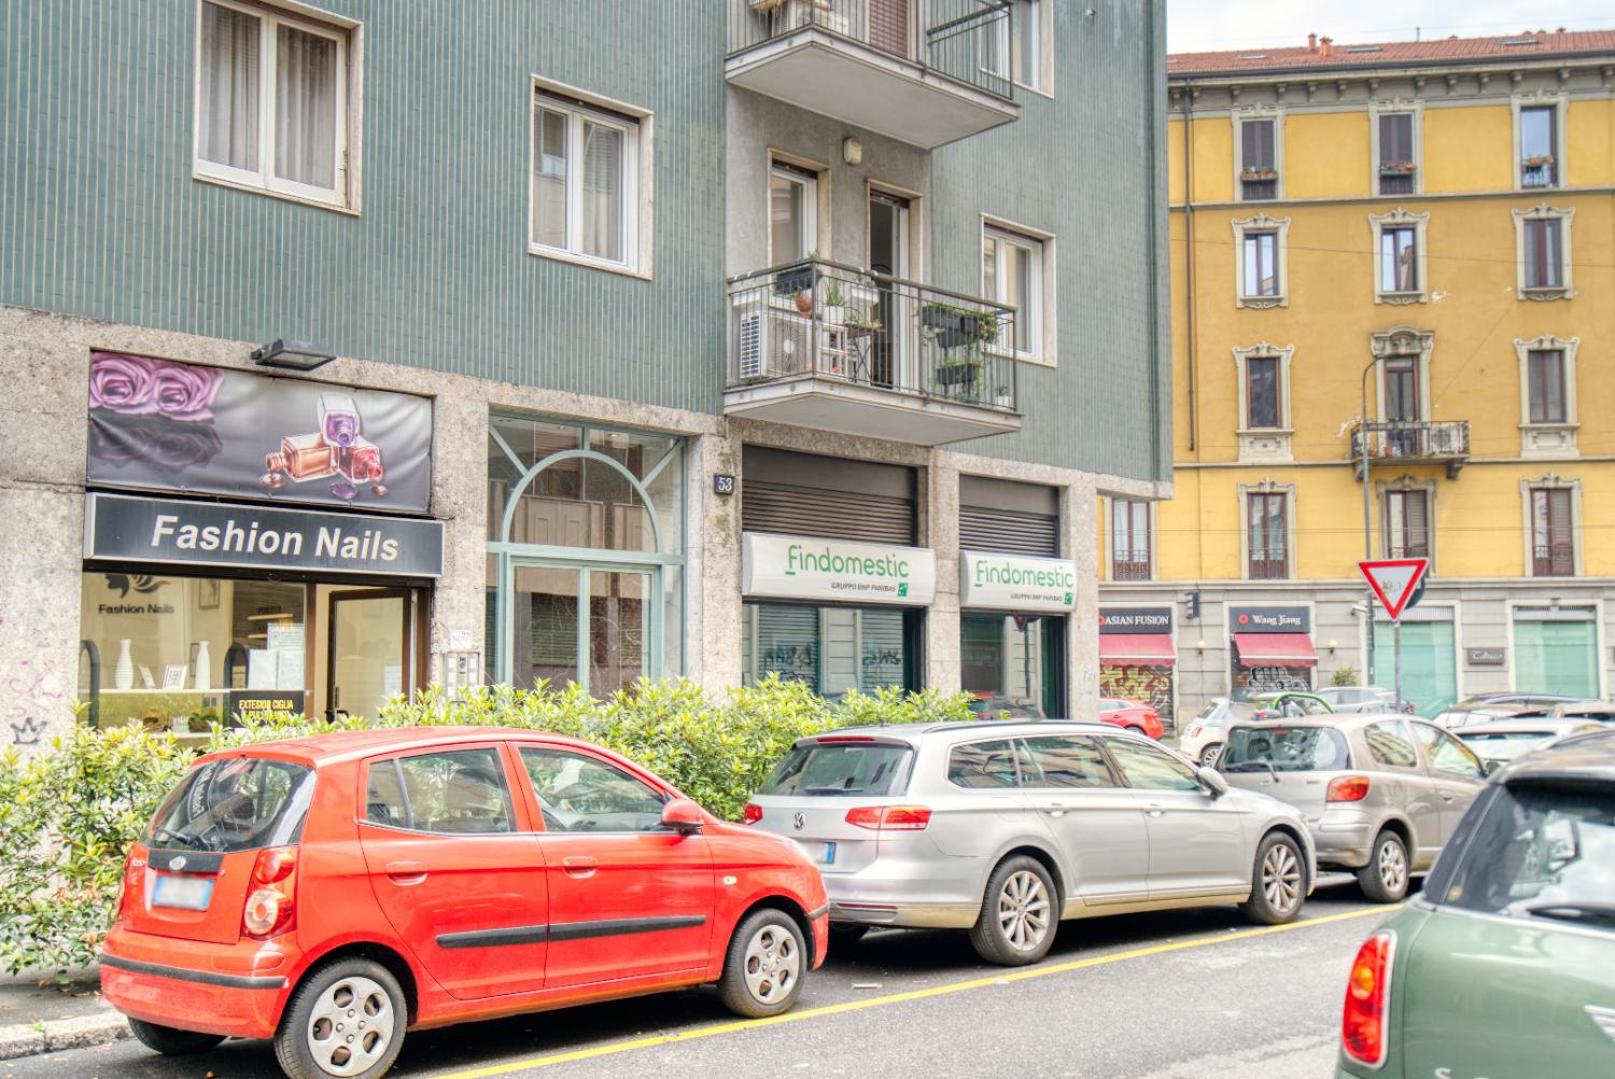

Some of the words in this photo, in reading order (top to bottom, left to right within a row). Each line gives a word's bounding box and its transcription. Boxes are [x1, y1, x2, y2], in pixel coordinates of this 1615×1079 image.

[718, 476, 732, 491] 53
[151, 514, 303, 556] Fashion
[315, 526, 399, 561] Nails
[785, 544, 909, 578] findomestic
[974, 559, 1074, 588] findomestic
[831, 582, 857, 590] GRUPPO
[871, 584, 896, 592] PARIBAS
[98, 604, 145, 614] Fashion
[147, 603, 175, 614] Nails
[1105, 615, 1133, 625] ASIAN
[1134, 615, 1169, 625] FUSION
[1252, 614, 1278, 626] Wang
[1278, 614, 1301, 626] Jiang
